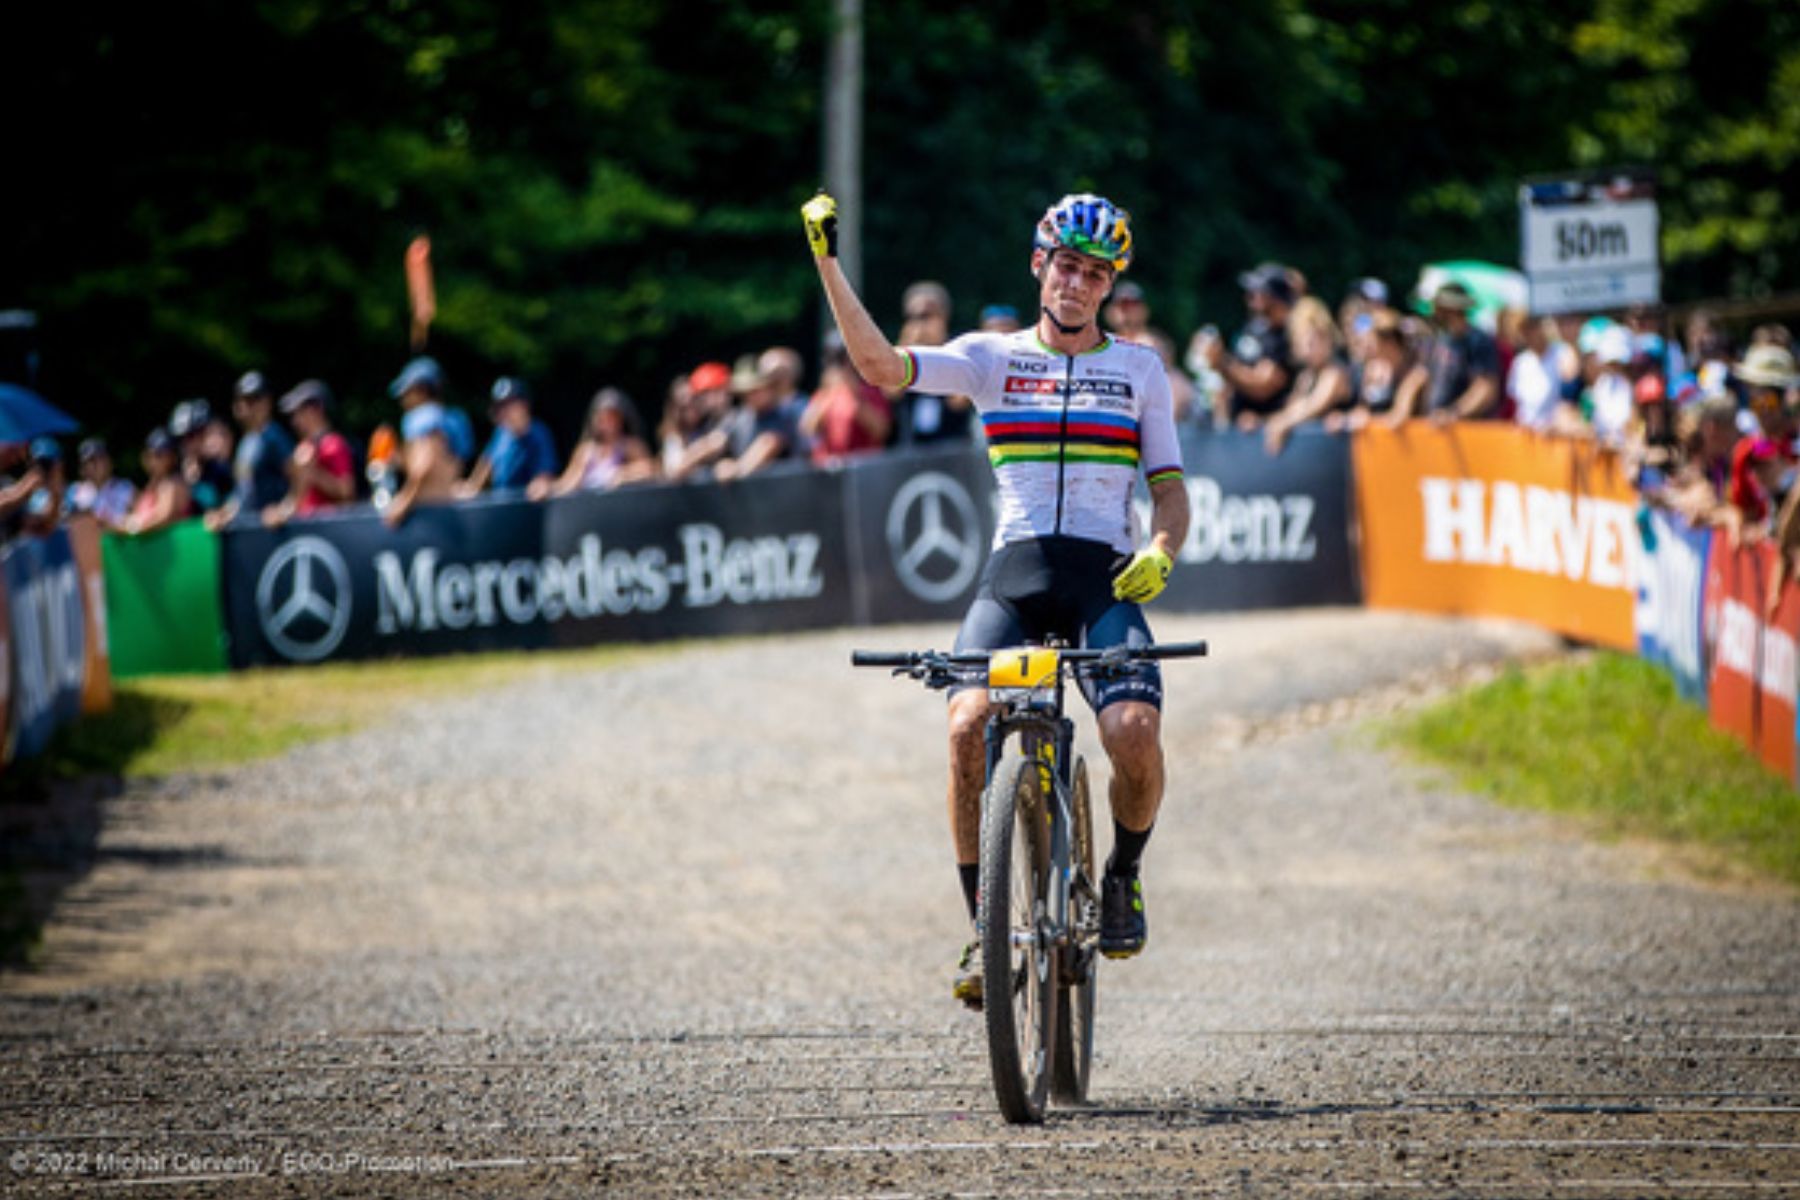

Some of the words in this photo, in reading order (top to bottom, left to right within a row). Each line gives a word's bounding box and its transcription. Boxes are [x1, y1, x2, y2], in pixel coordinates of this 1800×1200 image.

[1557, 219, 1629, 262] 50m
[1180, 475, 1317, 564] Benz
[374, 523, 824, 634] Mercedes-Benz
[1018, 654, 1029, 677] 1
